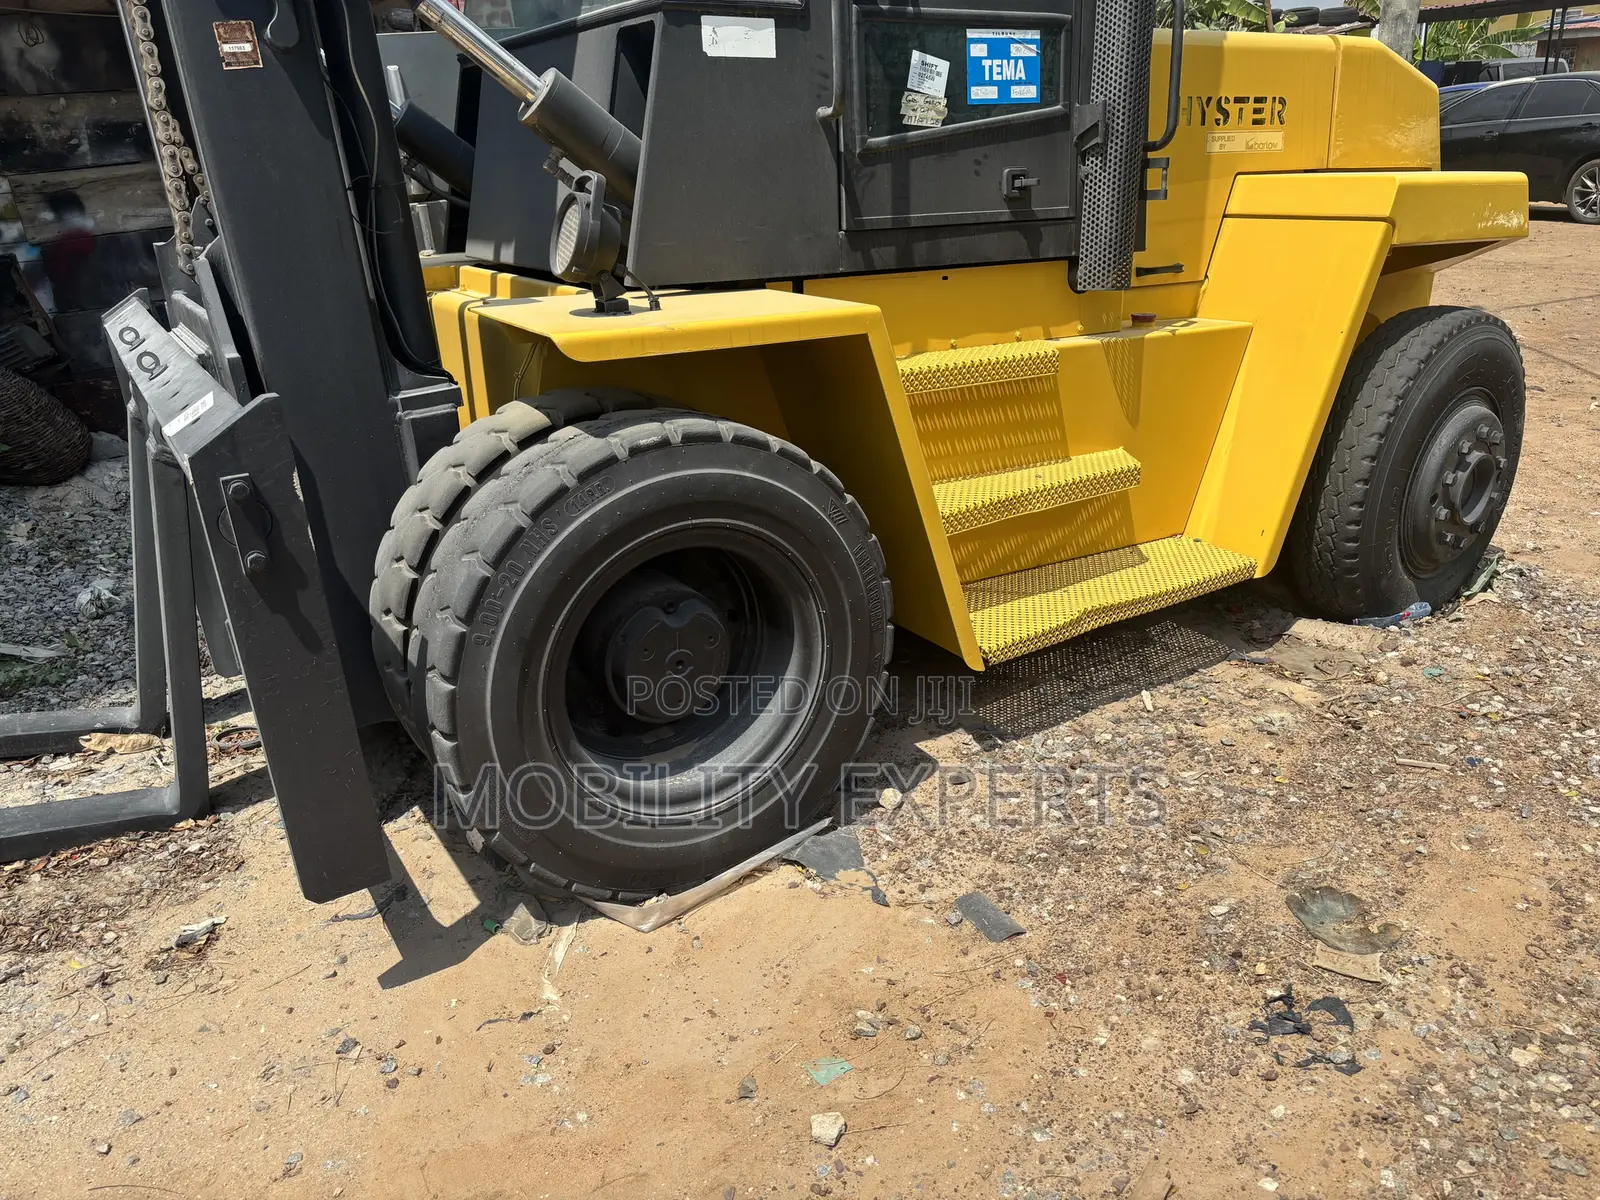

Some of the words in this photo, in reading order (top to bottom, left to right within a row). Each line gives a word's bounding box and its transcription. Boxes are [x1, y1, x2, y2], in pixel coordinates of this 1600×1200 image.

[920, 60, 939, 71] SHIFT
[981, 59, 1026, 81] TEMA
[1178, 96, 1287, 126] HYSTER
[1211, 135, 1236, 143] SUPPLIED
[519, 517, 559, 559] NHS
